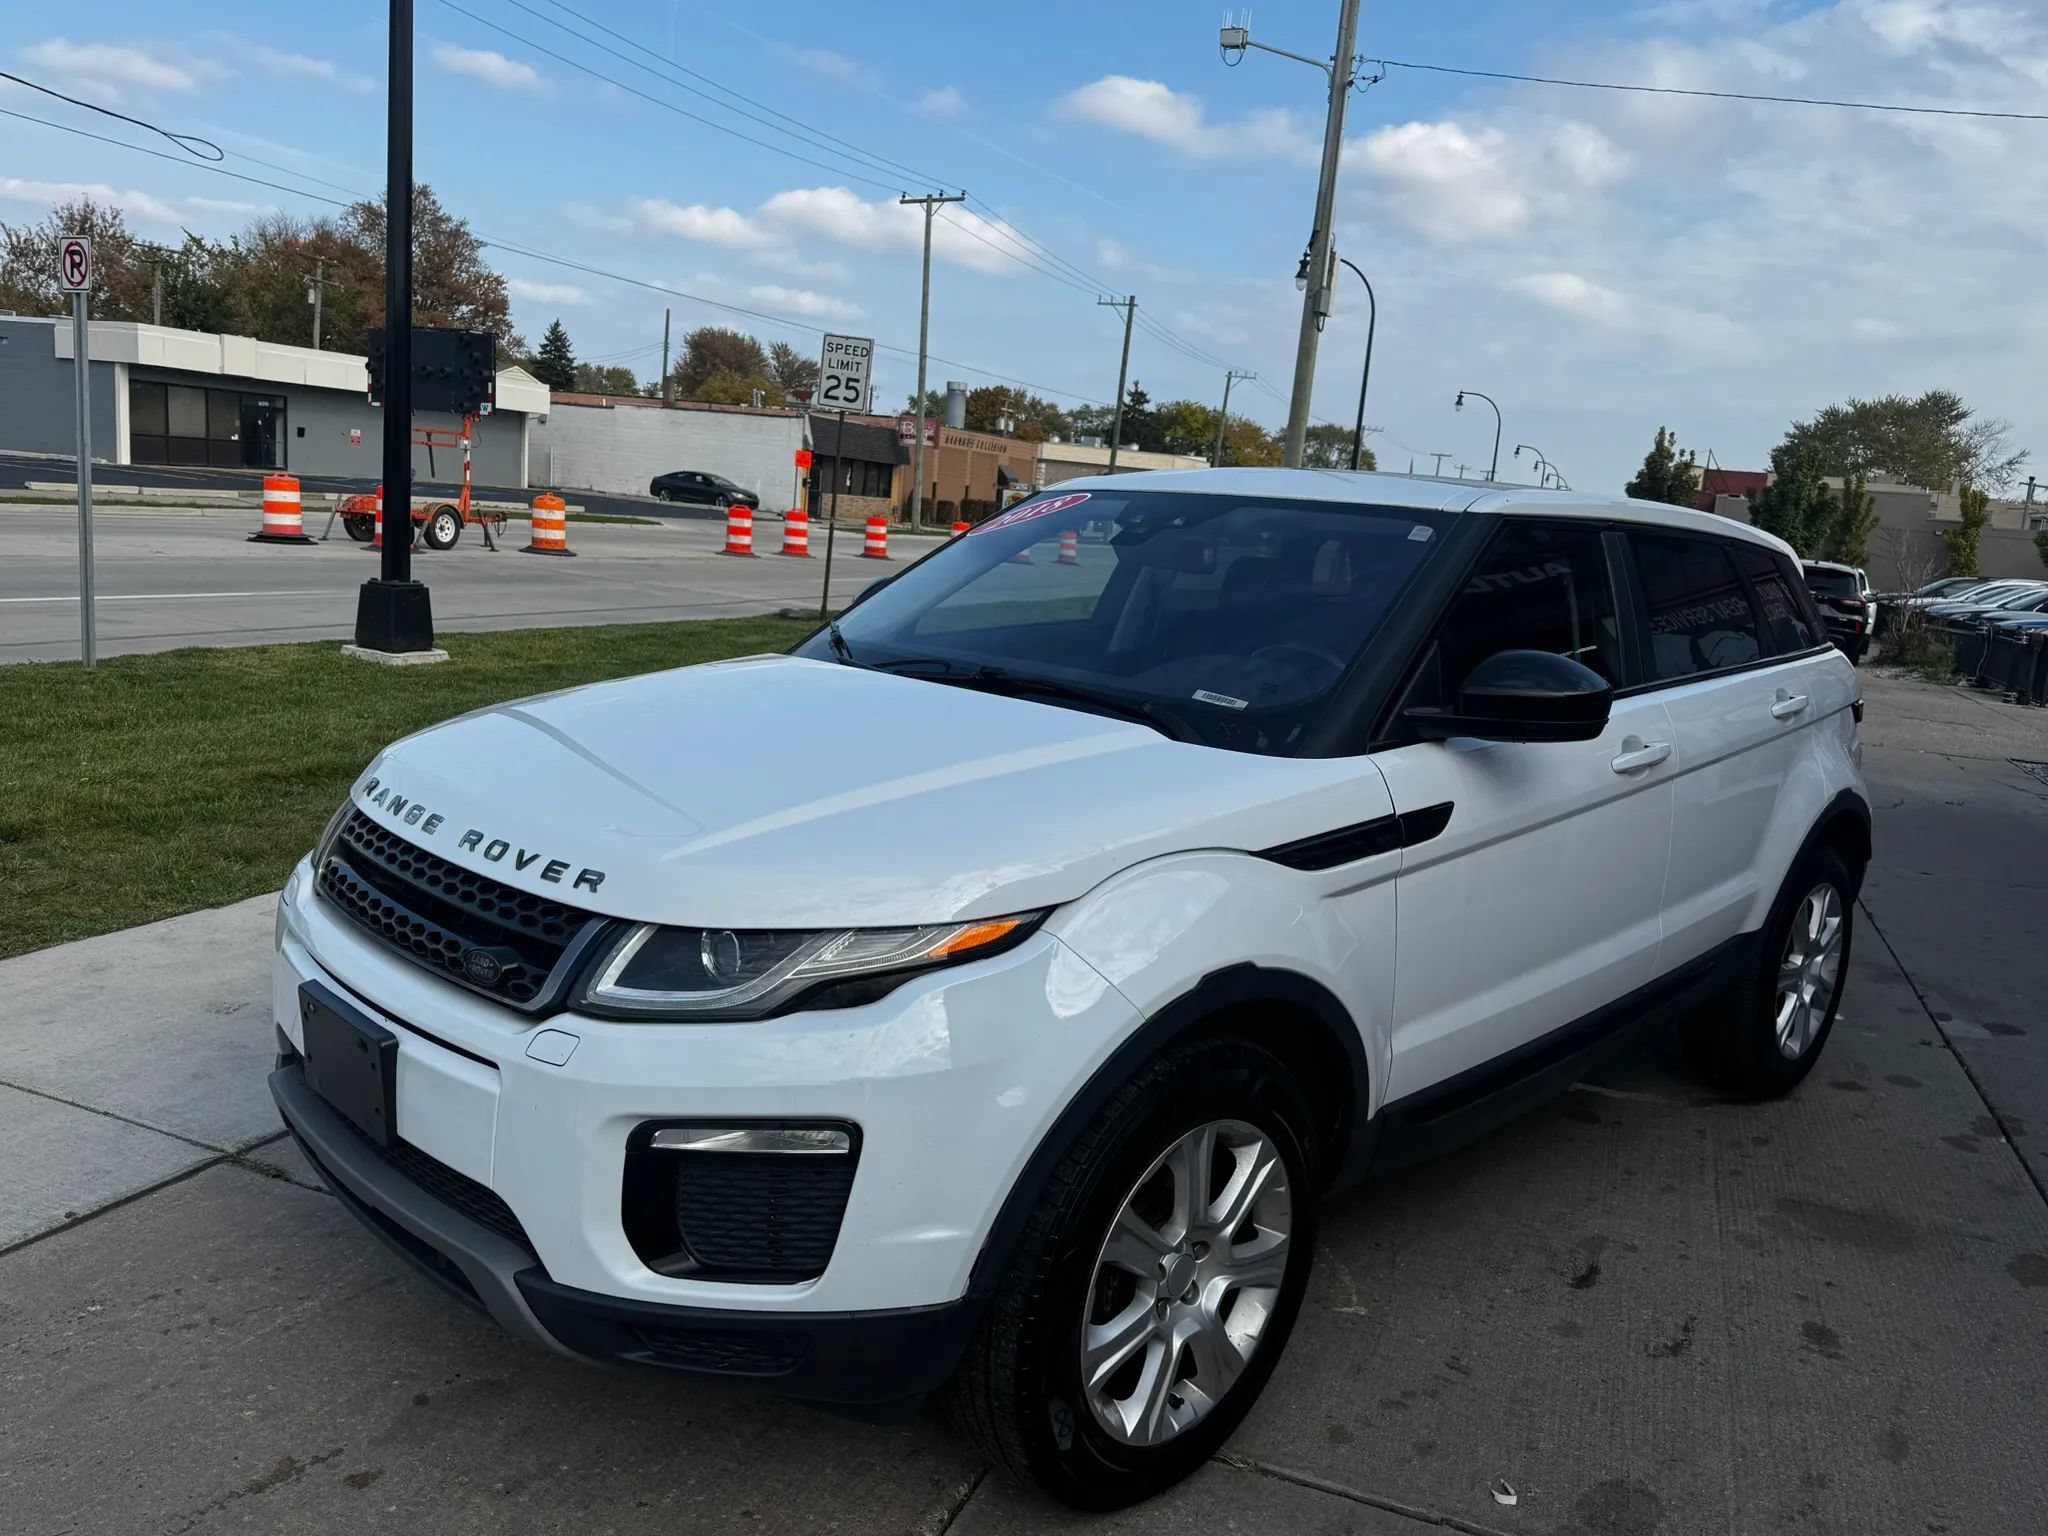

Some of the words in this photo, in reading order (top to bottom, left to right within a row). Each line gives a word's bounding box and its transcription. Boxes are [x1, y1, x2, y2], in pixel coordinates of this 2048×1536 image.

[826, 342, 869, 358] SPEED
[828, 357, 862, 372] LIMIT
[823, 374, 861, 403] 25
[362, 777, 445, 835] RANGE
[458, 829, 606, 893] ROVER
